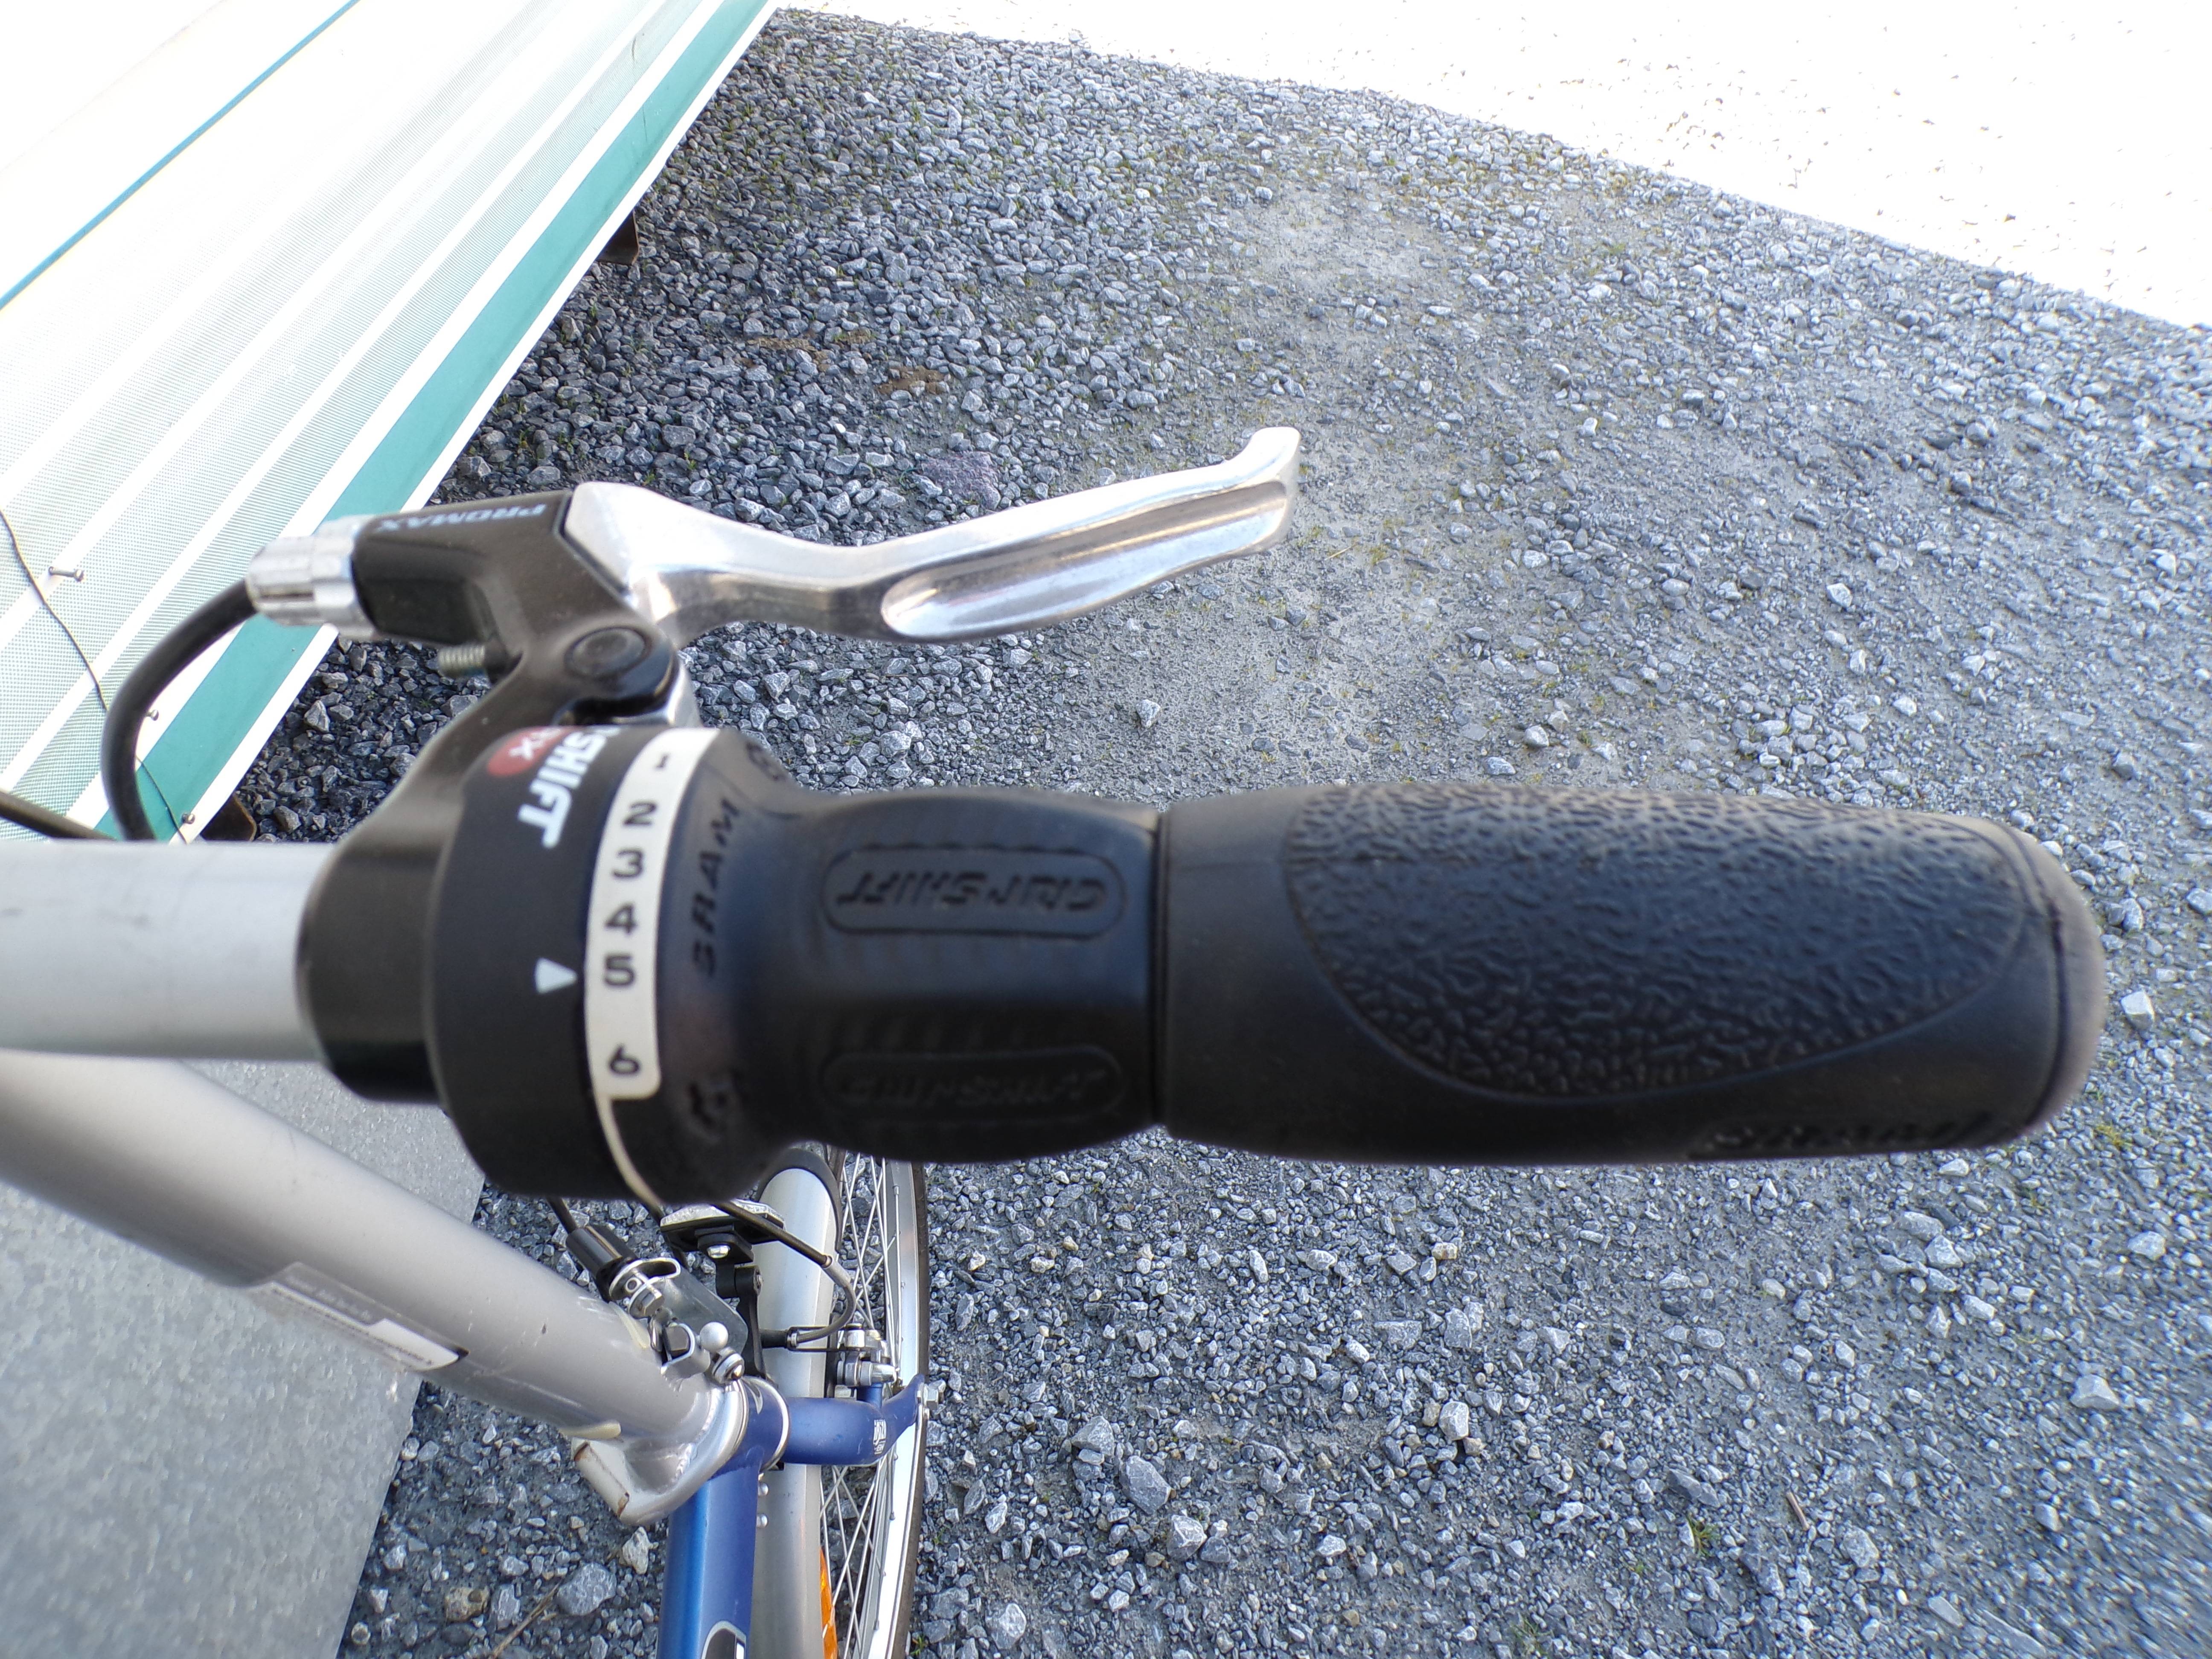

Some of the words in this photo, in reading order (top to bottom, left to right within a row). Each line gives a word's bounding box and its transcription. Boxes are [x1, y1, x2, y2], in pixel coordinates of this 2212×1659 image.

[623, 801, 658, 827] 2
[612, 849, 643, 877] 3
[692, 799, 739, 977] SRAM
[605, 903, 638, 934] 4
[603, 953, 635, 987] 5
[609, 1044, 640, 1076] 6
